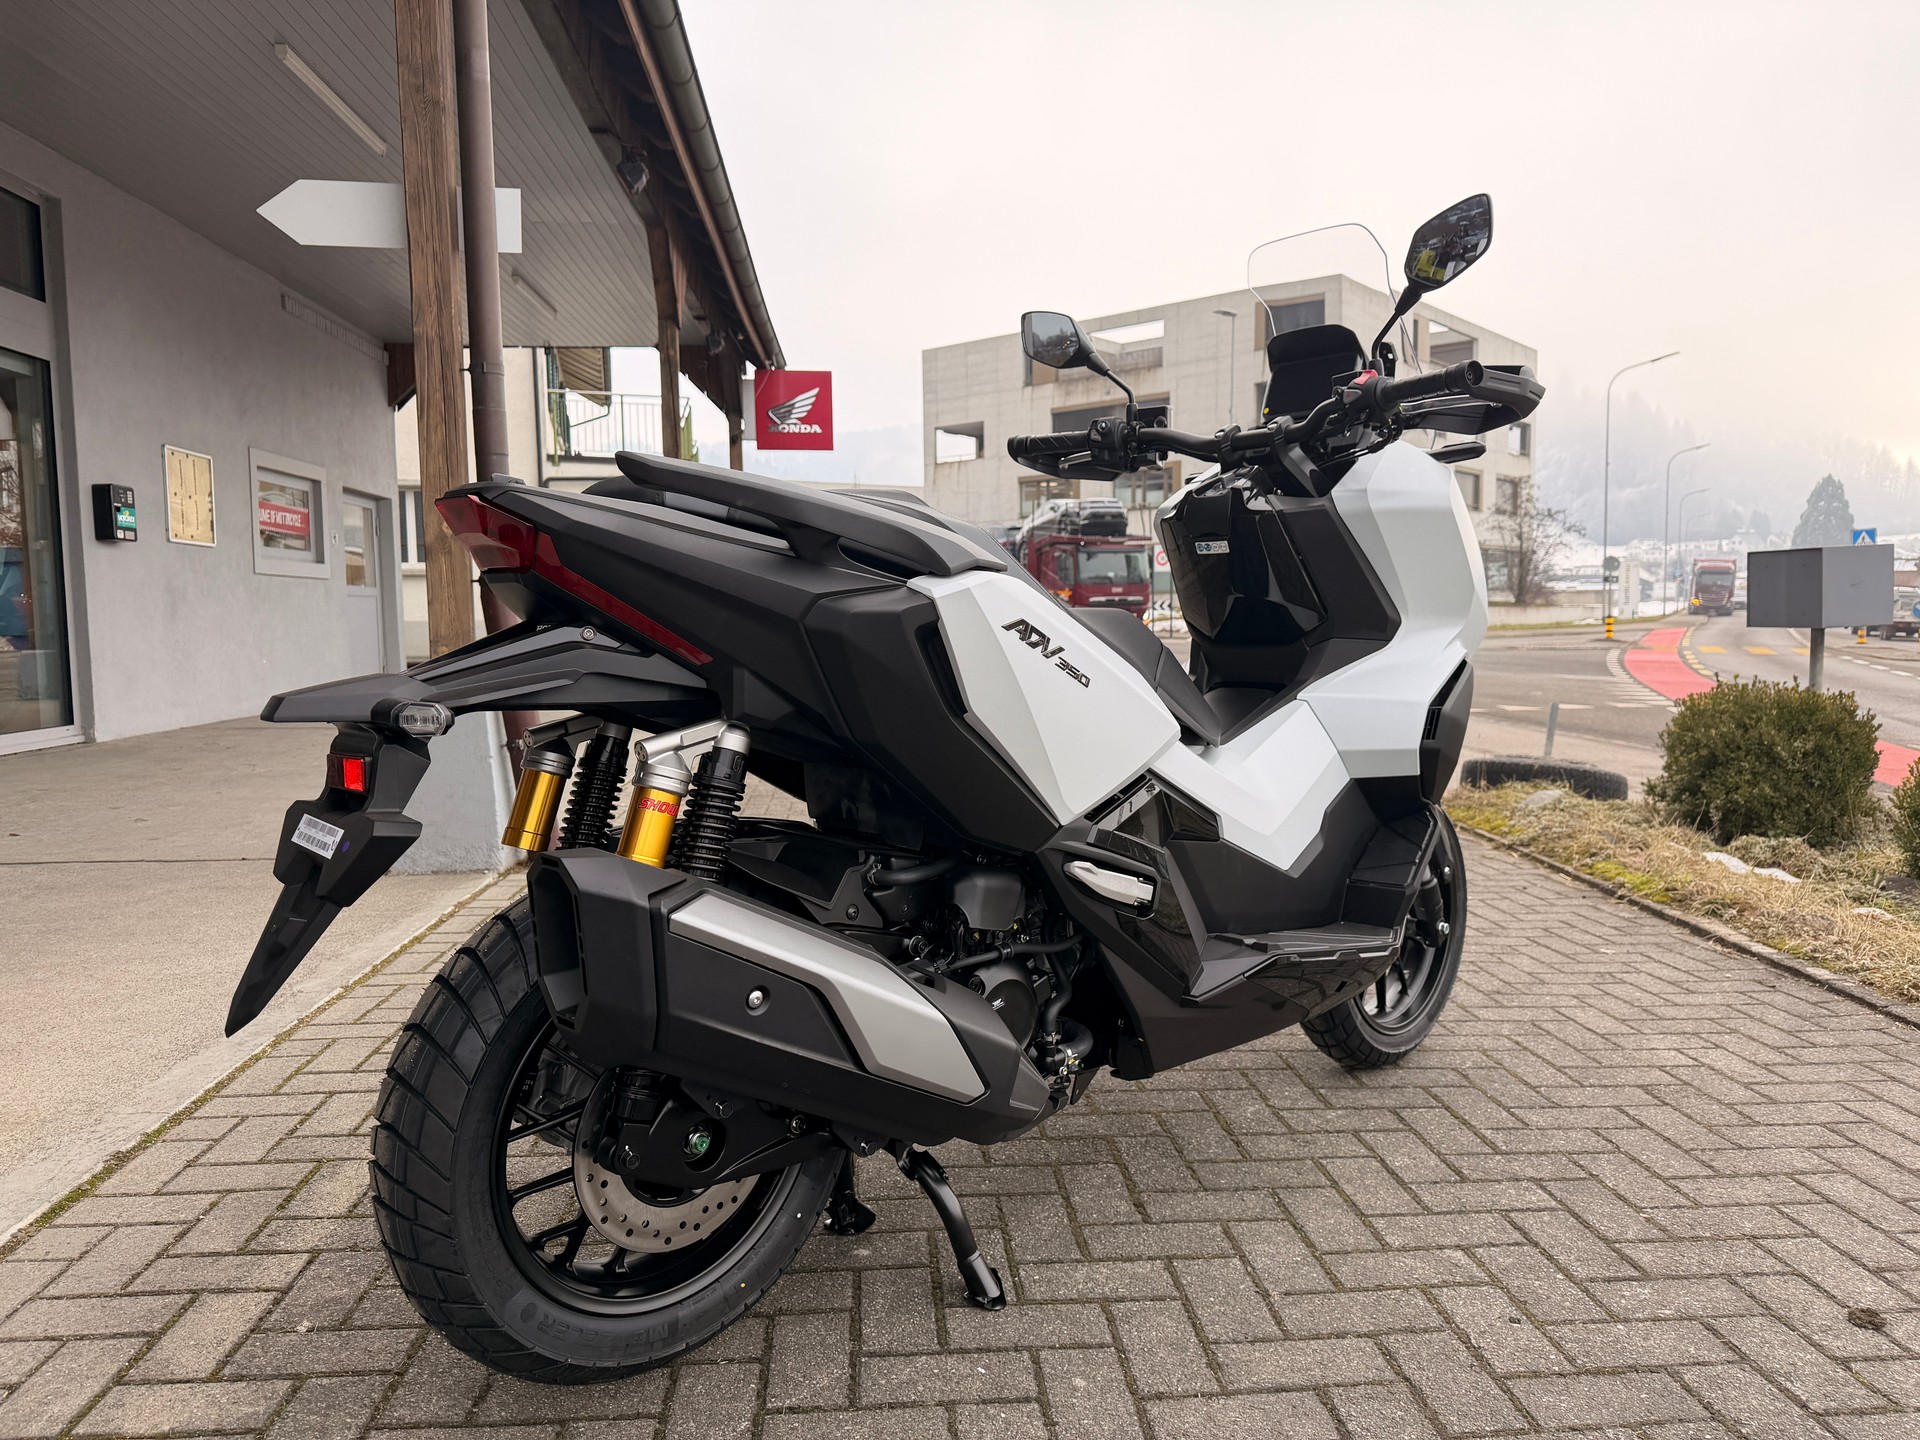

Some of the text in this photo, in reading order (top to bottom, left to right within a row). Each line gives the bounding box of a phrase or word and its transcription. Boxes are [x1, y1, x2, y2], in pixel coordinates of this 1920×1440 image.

[768, 424, 823, 434] HONDA
[1001, 617, 1091, 688] ADV 350
